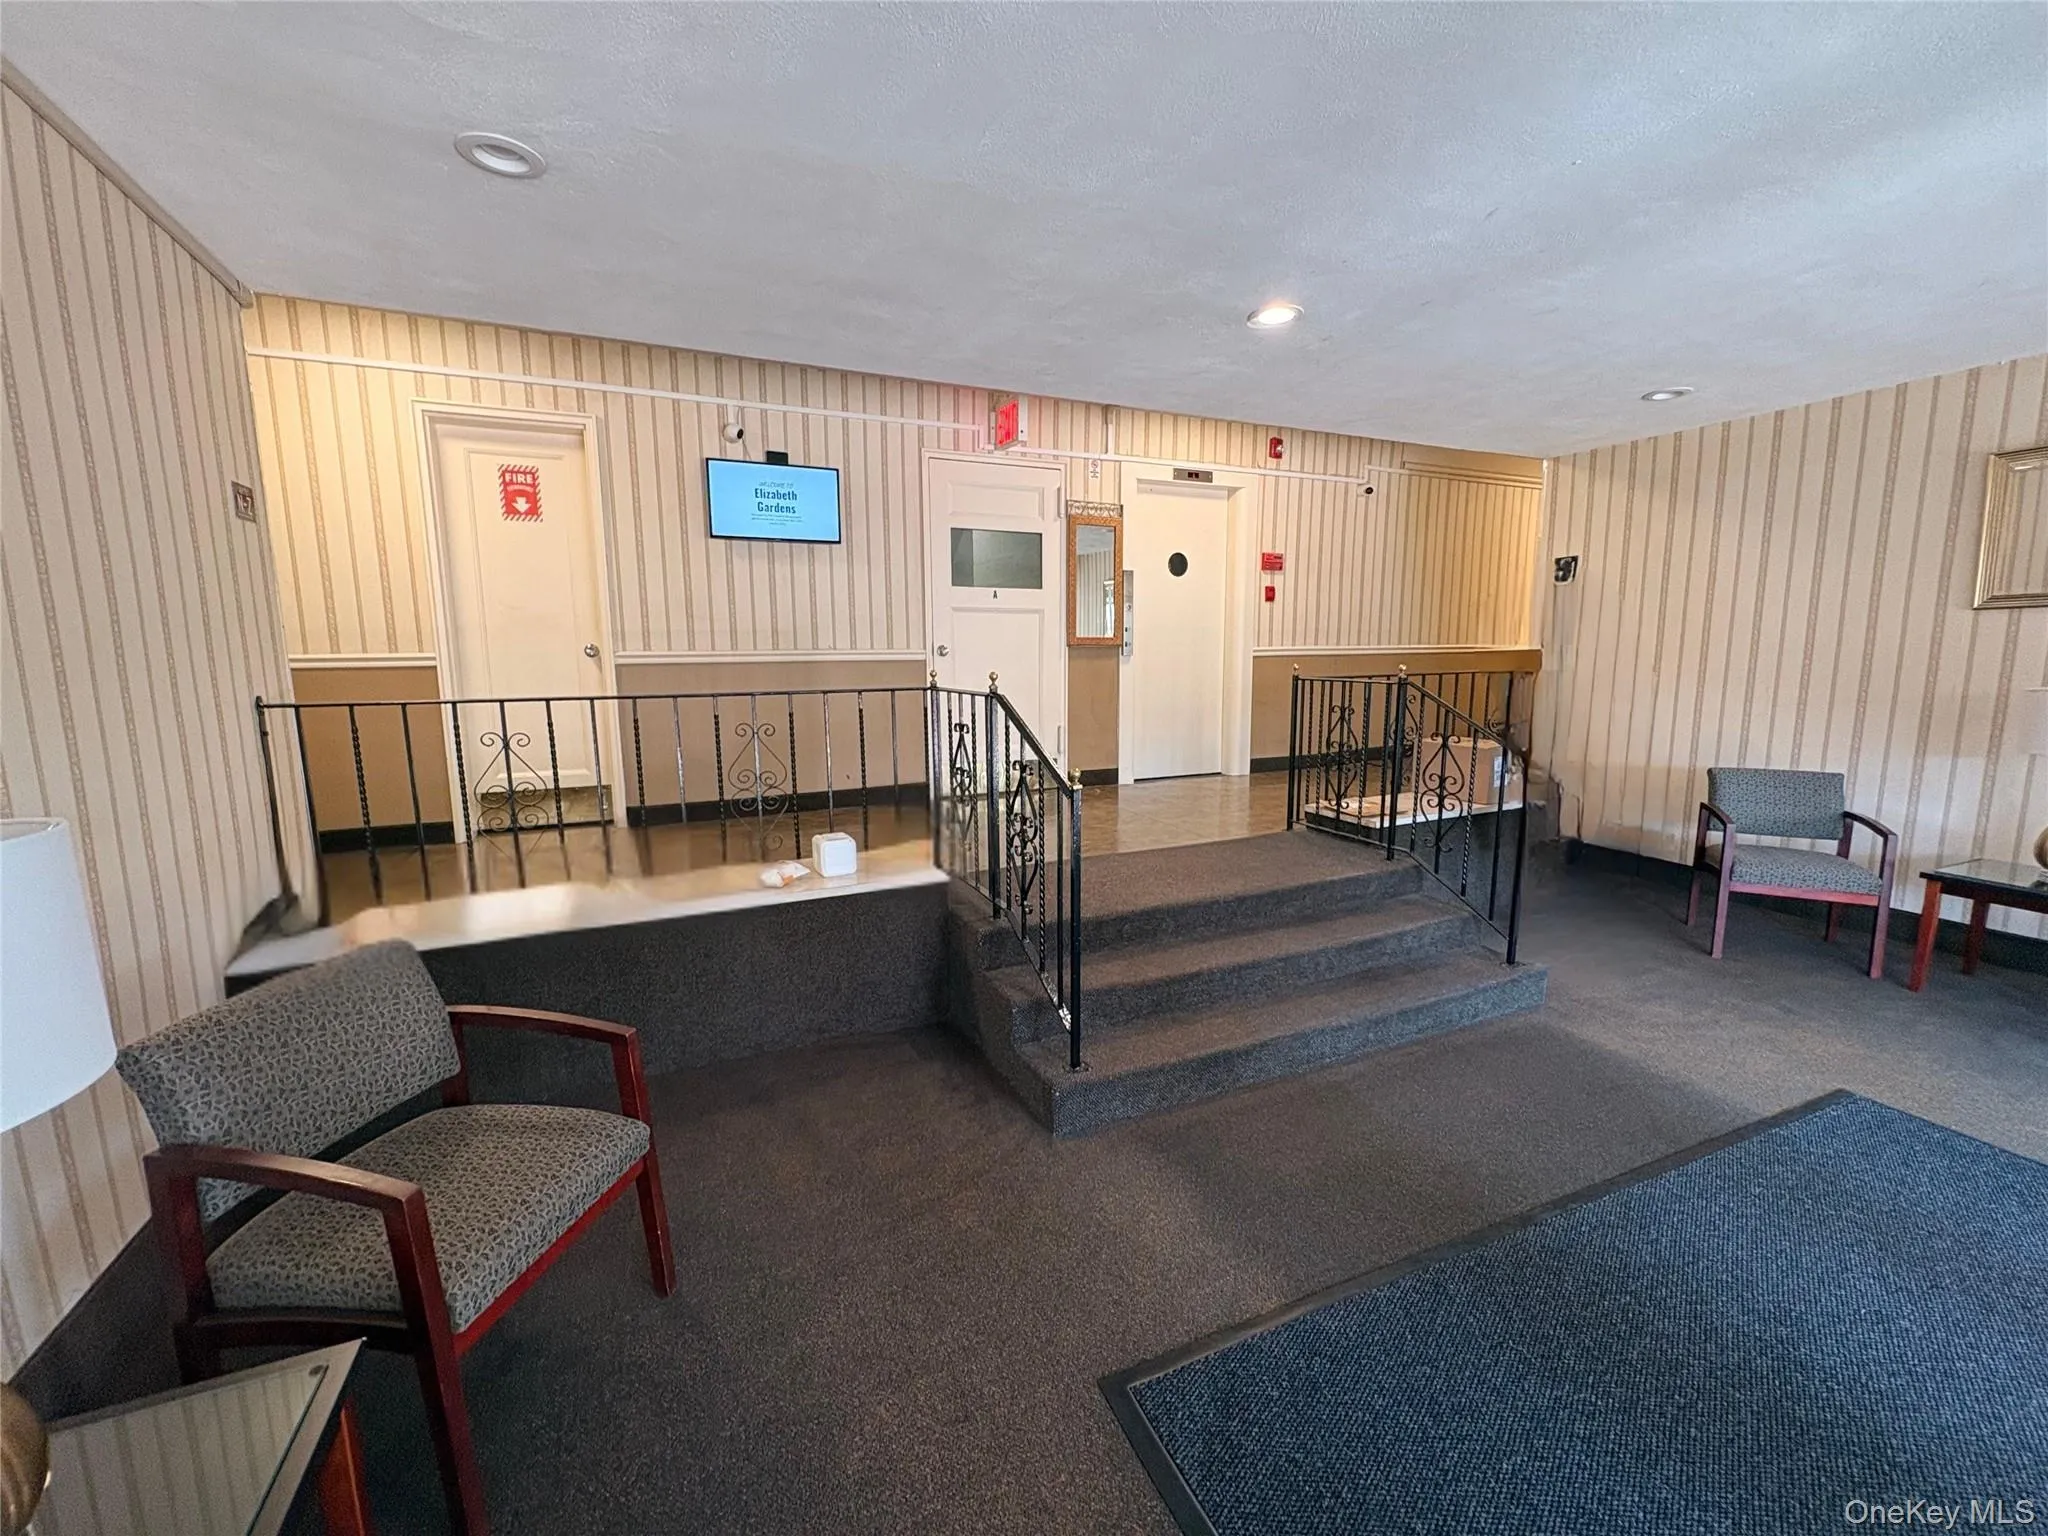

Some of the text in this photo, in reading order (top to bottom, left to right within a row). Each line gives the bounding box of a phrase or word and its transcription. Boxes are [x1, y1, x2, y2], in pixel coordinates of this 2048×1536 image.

[504, 472, 533, 484] FIRE
[754, 487, 798, 501] Elizabeth
[757, 501, 796, 514] Gardens
[992, 590, 998, 600] A
